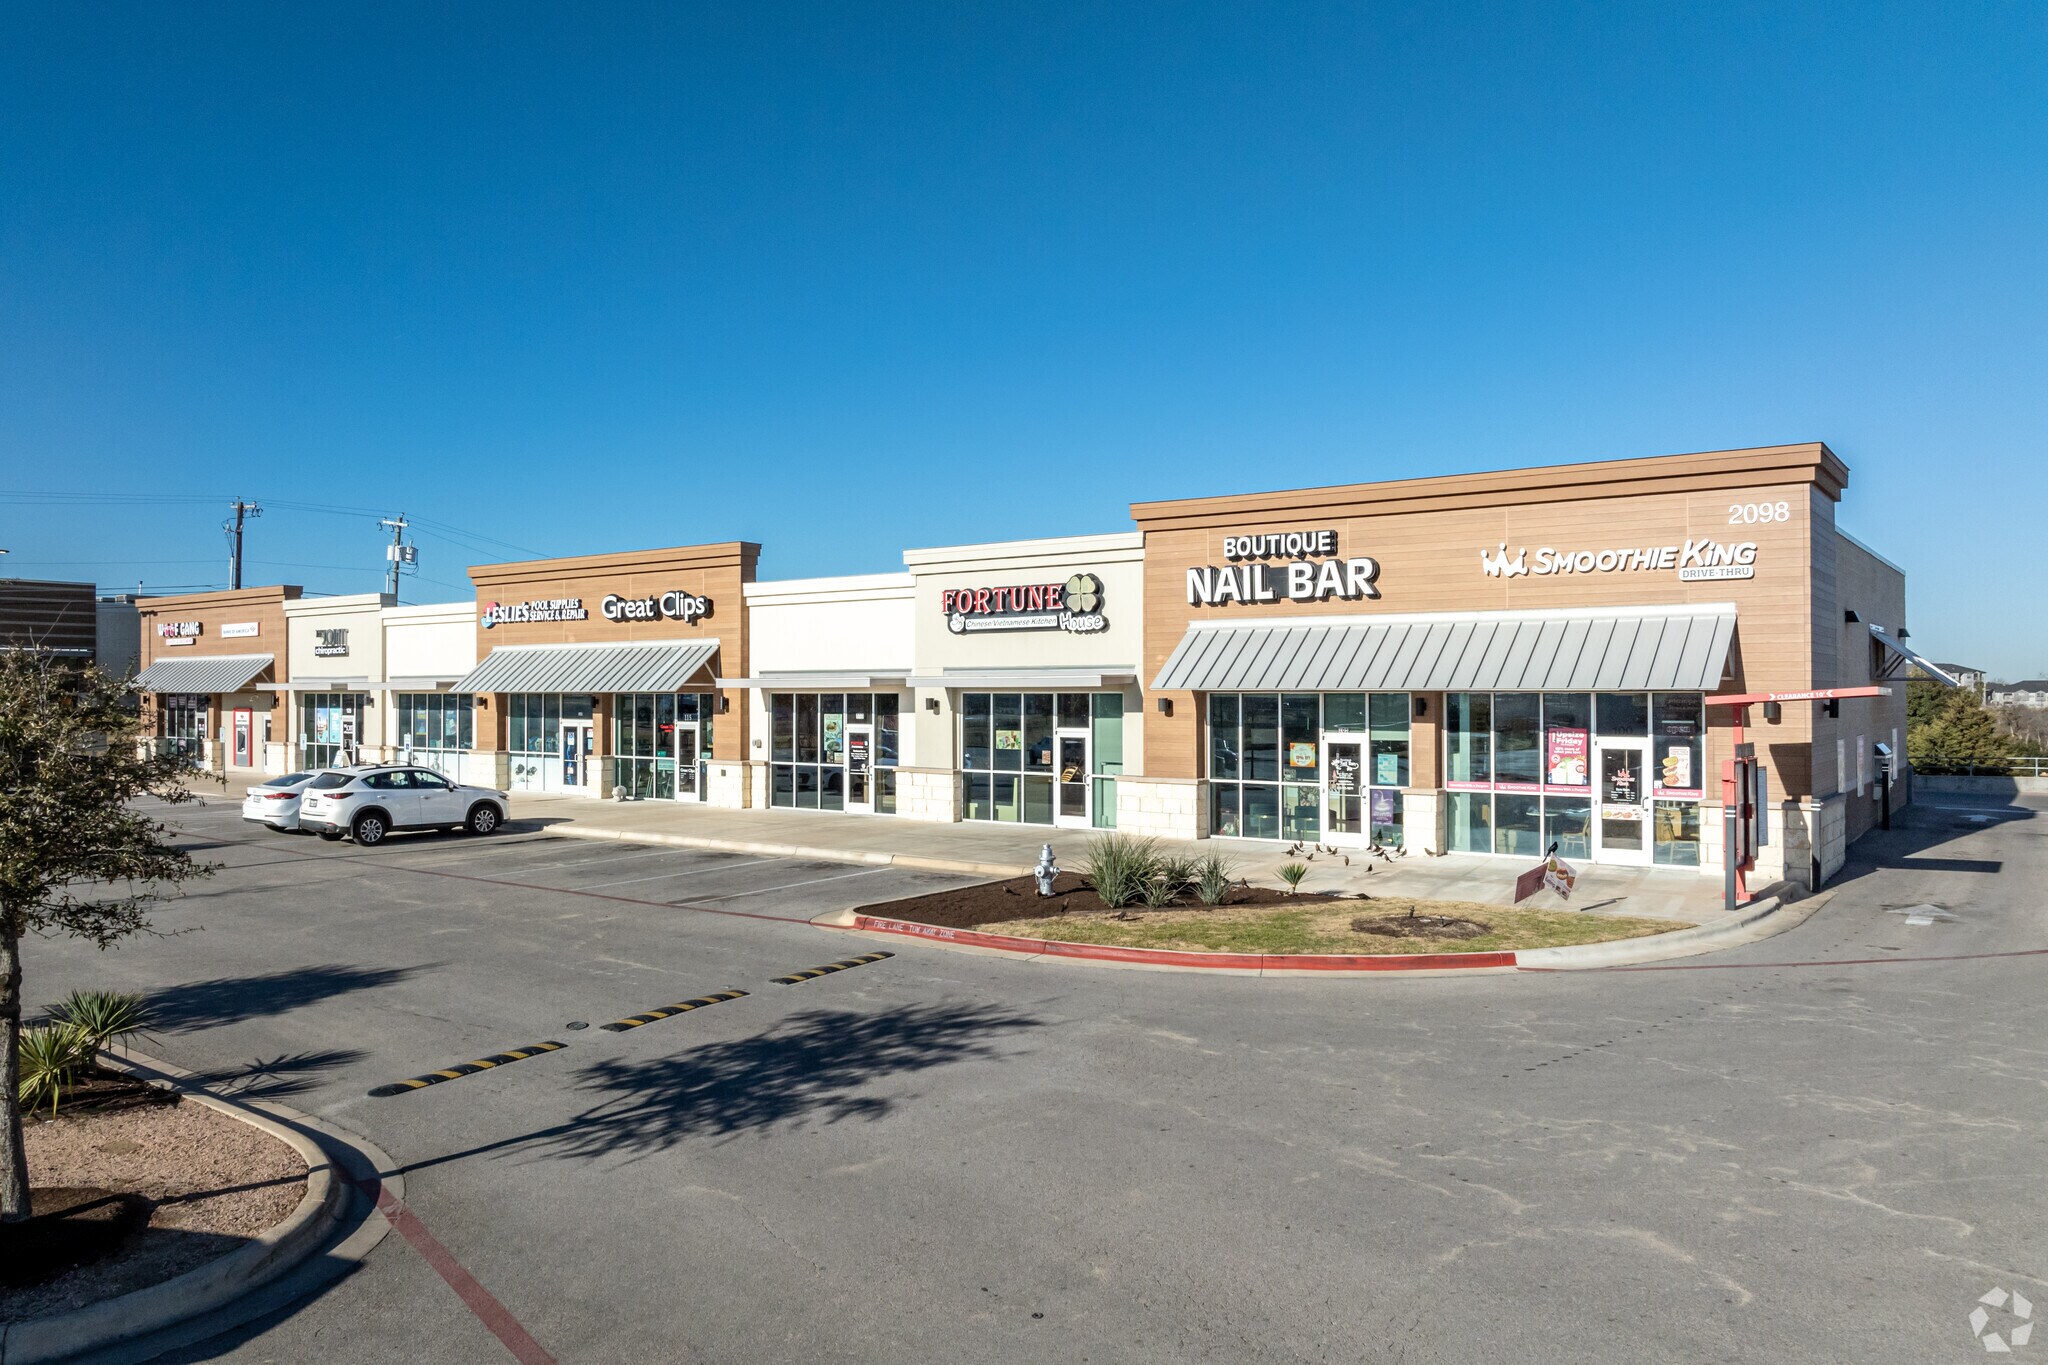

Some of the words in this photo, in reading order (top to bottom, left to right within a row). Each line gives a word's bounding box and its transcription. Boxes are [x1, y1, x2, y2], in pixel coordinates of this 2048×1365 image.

[1728, 501, 1790, 524] 2098
[1223, 531, 1331, 558] BOUTIQUE
[1532, 546, 1679, 575] SMOOTHIE
[1187, 565, 1274, 604] NAIL
[1288, 558, 1375, 599] BAR
[1682, 568, 1750, 578] DRIVE-THRU
[531, 600, 549, 611] POOL
[550, 599, 579, 609] SUPPLIES
[601, 595, 654, 618] Great
[660, 592, 705, 622] Clips
[941, 584, 1065, 614] FORTUNE
[485, 602, 530, 623] LESLIE'S
[530, 610, 556, 621] SERVICE
[555, 610, 561, 620] &
[562, 608, 586, 619] REPAIR
[1059, 611, 1106, 631] House
[179, 622, 200, 636] GANG
[967, 619, 1030, 628] Chinese/Vietnamese
[1031, 617, 1057, 626] Kitchen
[315, 647, 345, 656] chiropractic
[1777, 692, 1815, 700] CLEARANCE
[1556, 737, 1583, 746] Friday
[873, 920, 887, 929] FIRE
[888, 923, 904, 932] LANE
[909, 925, 921, 934] TOW
[923, 927, 937, 936] AWAY
[939, 929, 956, 939] ZONE
